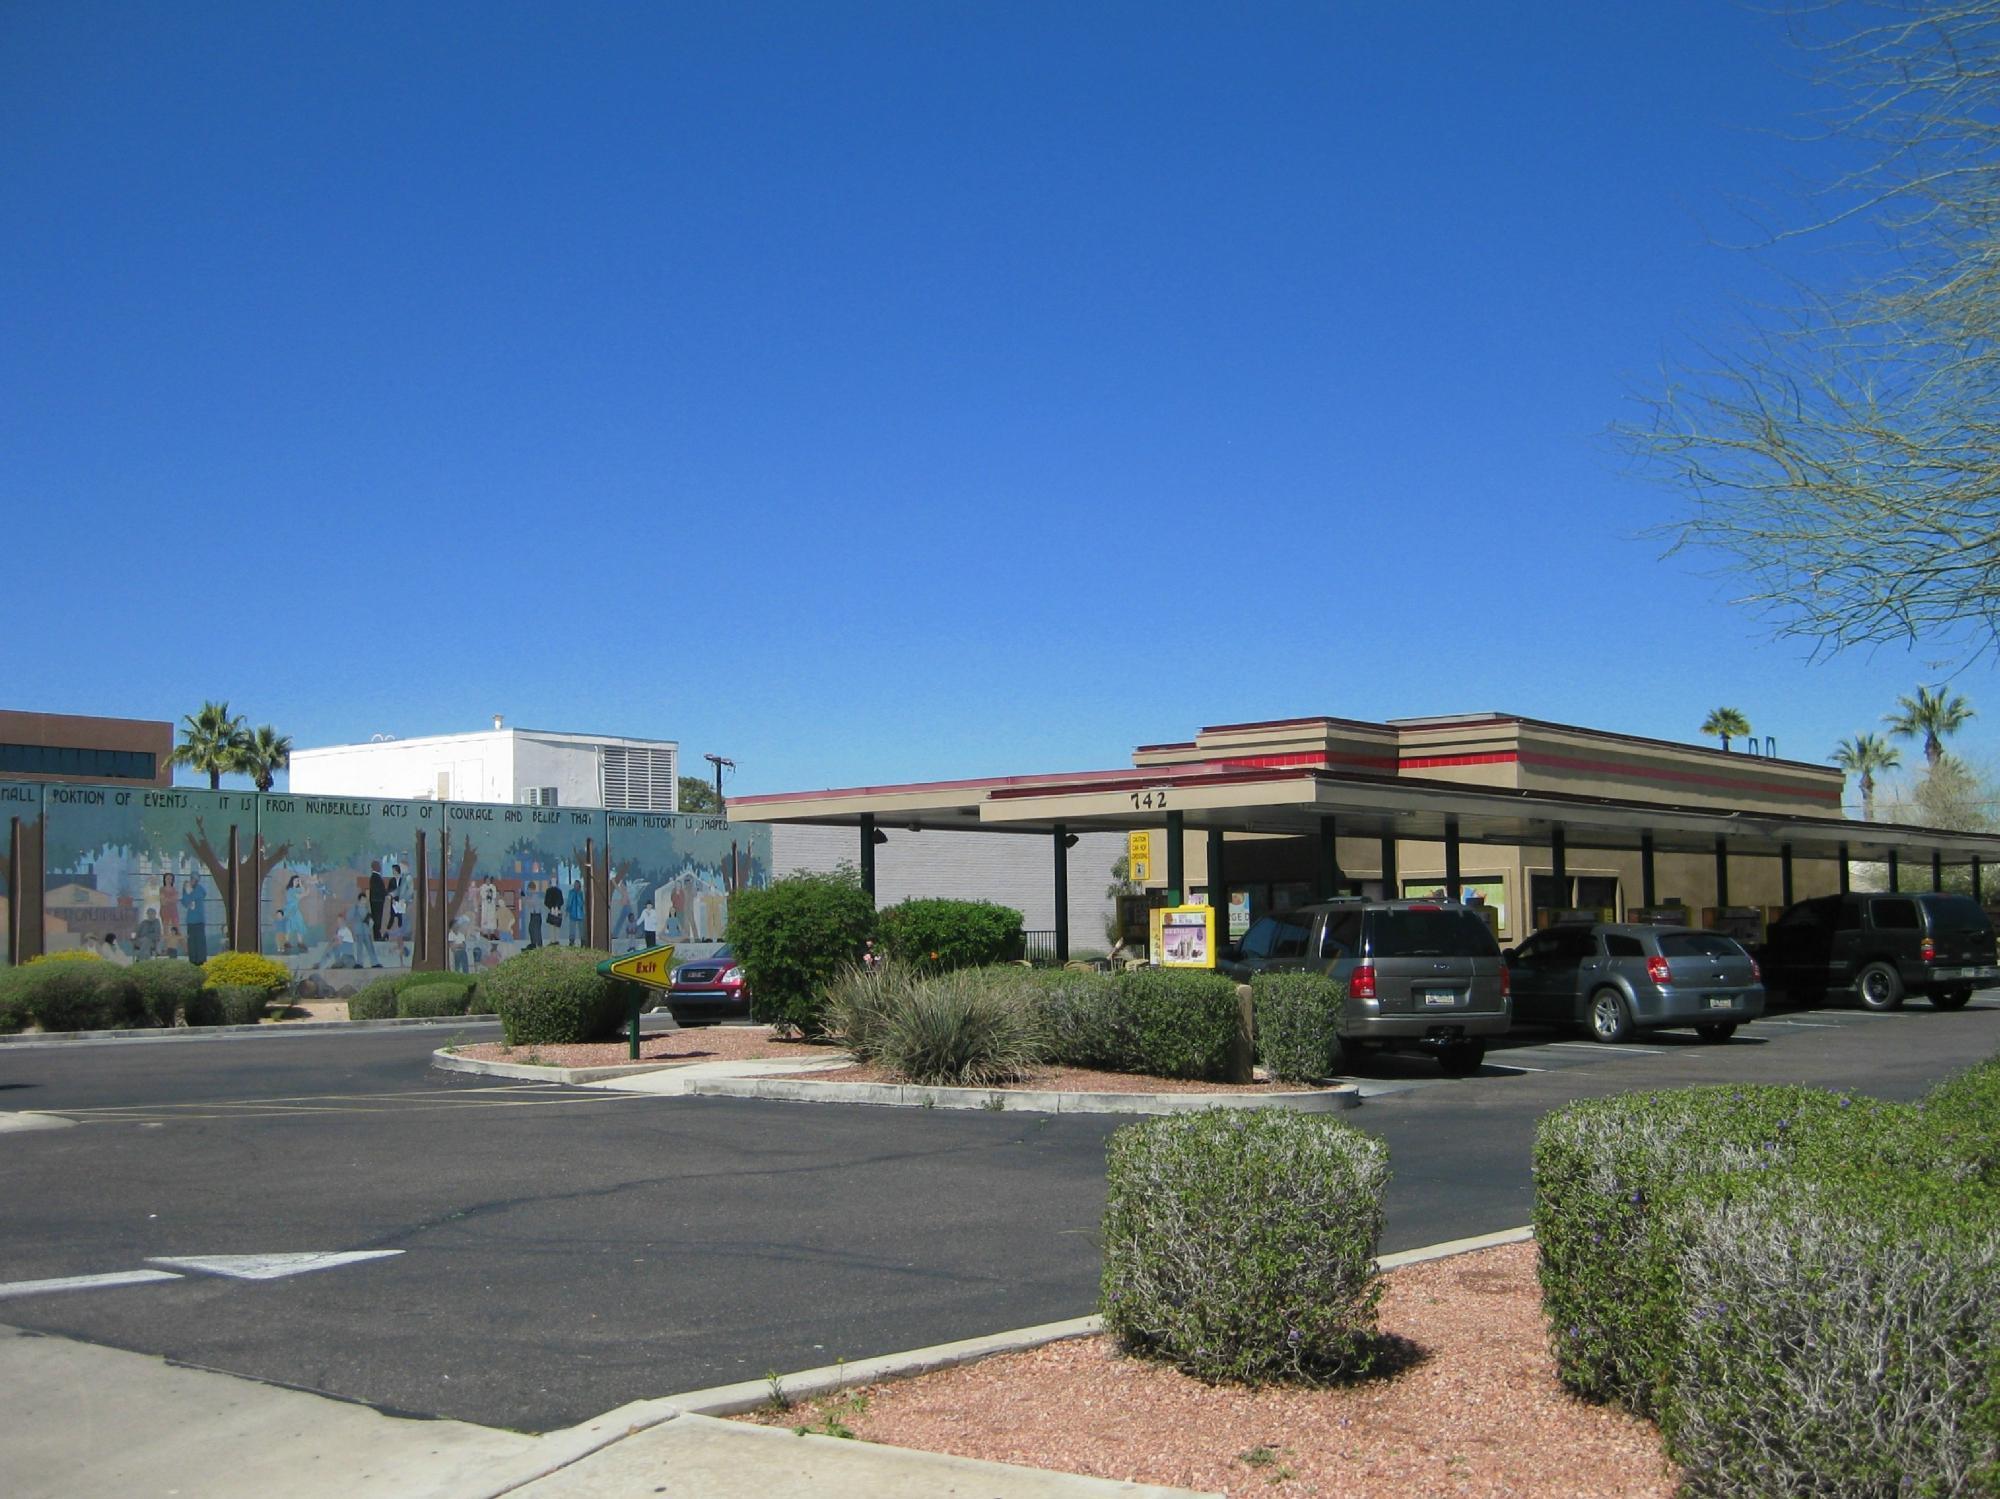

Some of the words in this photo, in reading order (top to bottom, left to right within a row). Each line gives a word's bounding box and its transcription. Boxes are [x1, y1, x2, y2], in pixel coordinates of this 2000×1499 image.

[53, 789, 104, 804] PORTION
[115, 792, 131, 806] OF
[219, 797, 230, 810] IT
[241, 798, 251, 811] IS
[266, 799, 294, 813] FROM
[306, 801, 371, 816] NUMBERLESS
[383, 804, 408, 817] ACTS
[420, 806, 432, 818] OF
[450, 807, 494, 821] COURAGE
[505, 810, 522, 822] AND
[533, 810, 560, 823] BELIEF
[571, 812, 592, 825] THAT
[608, 815, 637, 828] HUMAN
[643, 816, 675, 829] HISTORY
[685, 819, 692, 829] IS
[1131, 792, 1167, 810] 742
[636, 961, 656, 974] Exit
